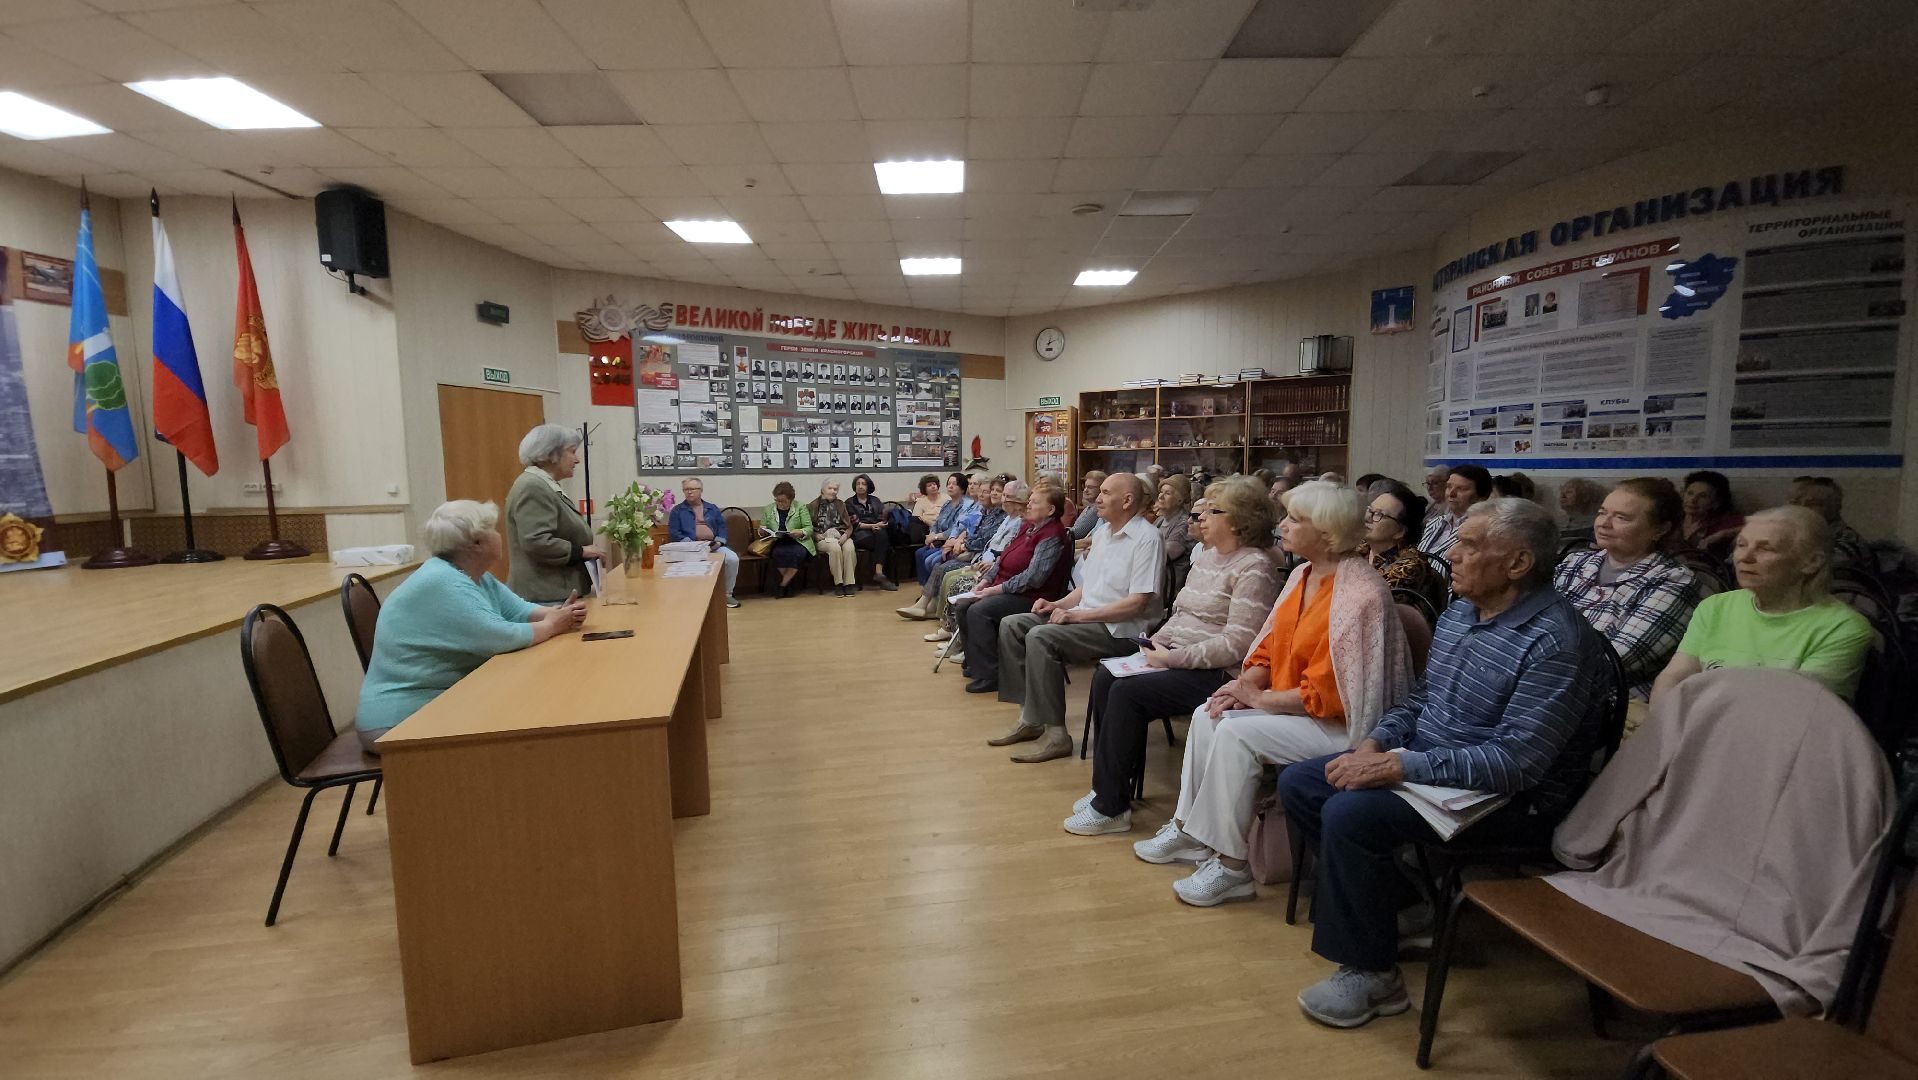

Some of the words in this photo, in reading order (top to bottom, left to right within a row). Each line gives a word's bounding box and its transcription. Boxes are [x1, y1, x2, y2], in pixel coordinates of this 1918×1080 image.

[1550, 165, 1844, 246] ОРГАНИЗАЦИЯ
[1526, 263, 1565, 281] СОВЕТ
[1571, 244, 1660, 271] ВЕТЕРАНОВ
[675, 304, 763, 332] ВЕЛИКОЙ
[769, 313, 837, 341] ПОБЕДЕ
[842, 321, 887, 342] ЖИТЬ
[890, 326, 901, 343] В
[903, 327, 952, 347] ВЕКАХ
[485, 369, 509, 382] ВЫХОД
